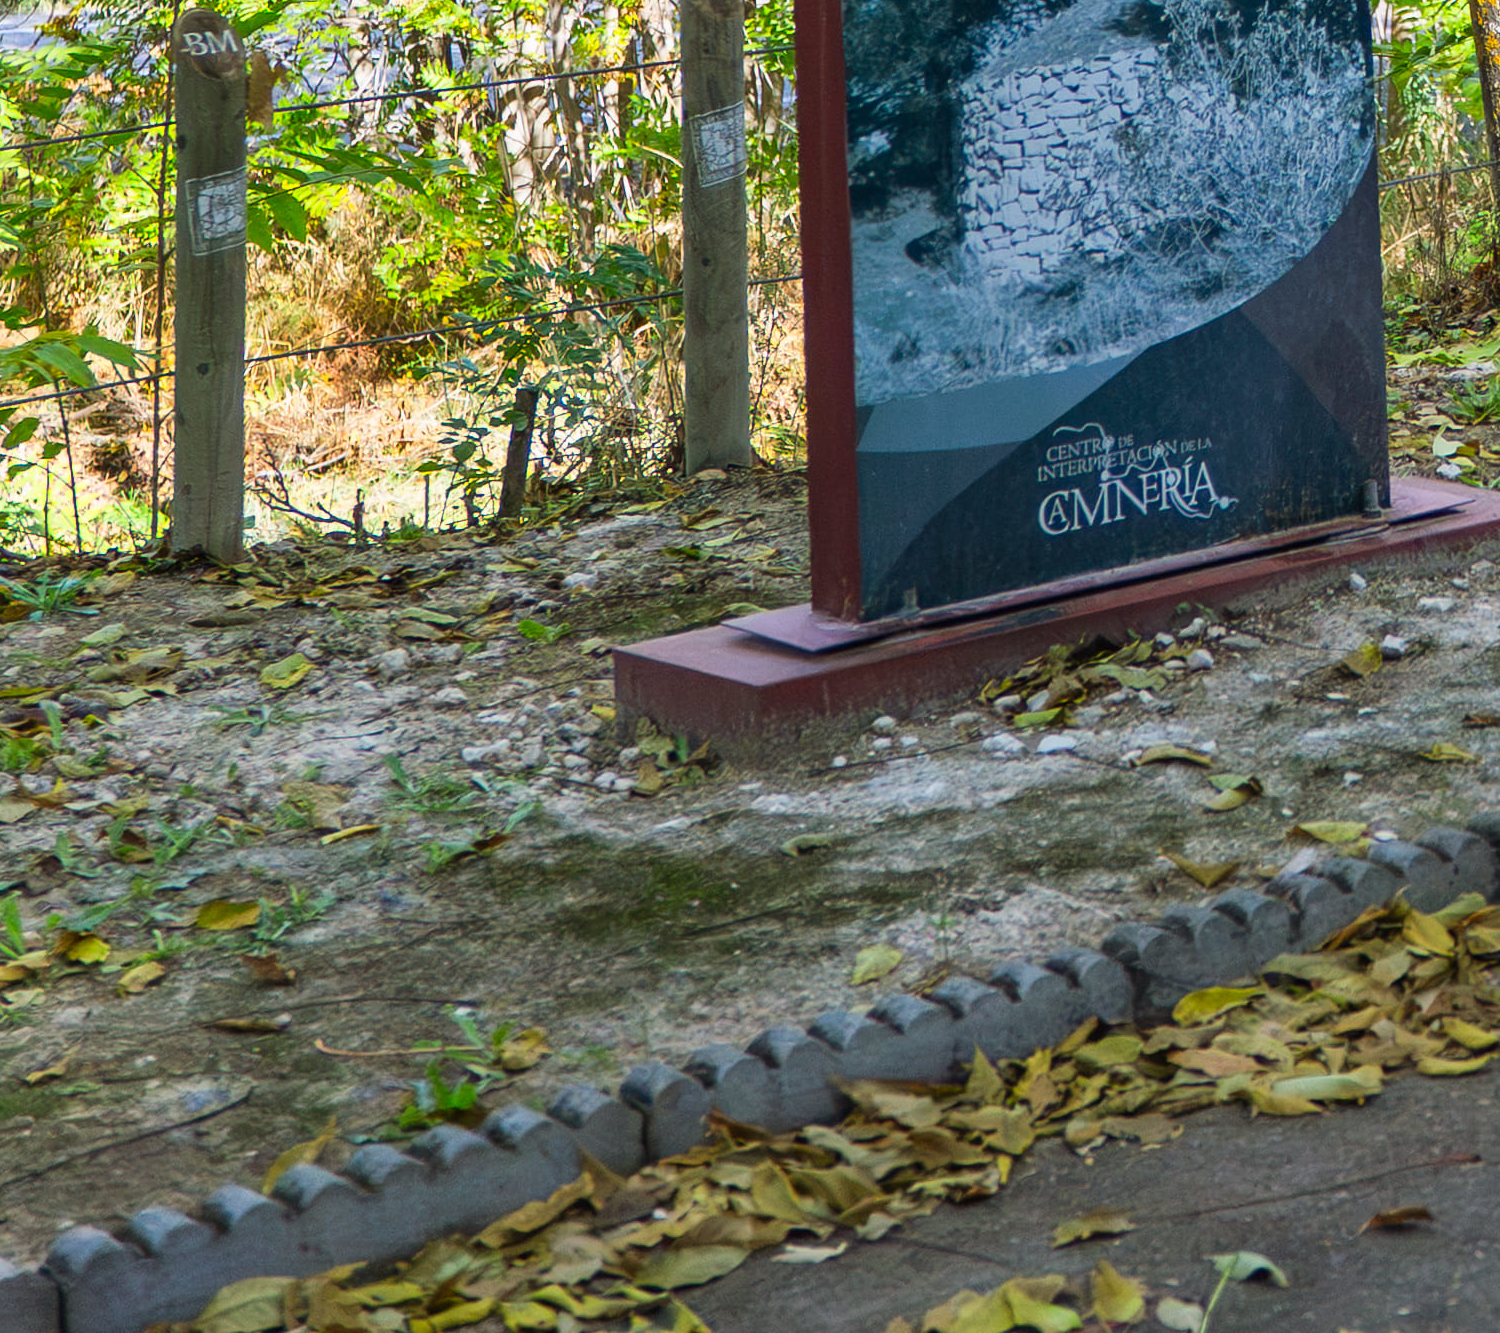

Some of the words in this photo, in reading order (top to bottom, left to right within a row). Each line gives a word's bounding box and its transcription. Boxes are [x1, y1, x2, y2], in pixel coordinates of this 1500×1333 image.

[1118, 434, 1134, 447] DE
[1037, 439, 1177, 482] INTERPRETACIÓN
[1181, 440, 1196, 453] DE
[1197, 437, 1212, 450] LA
